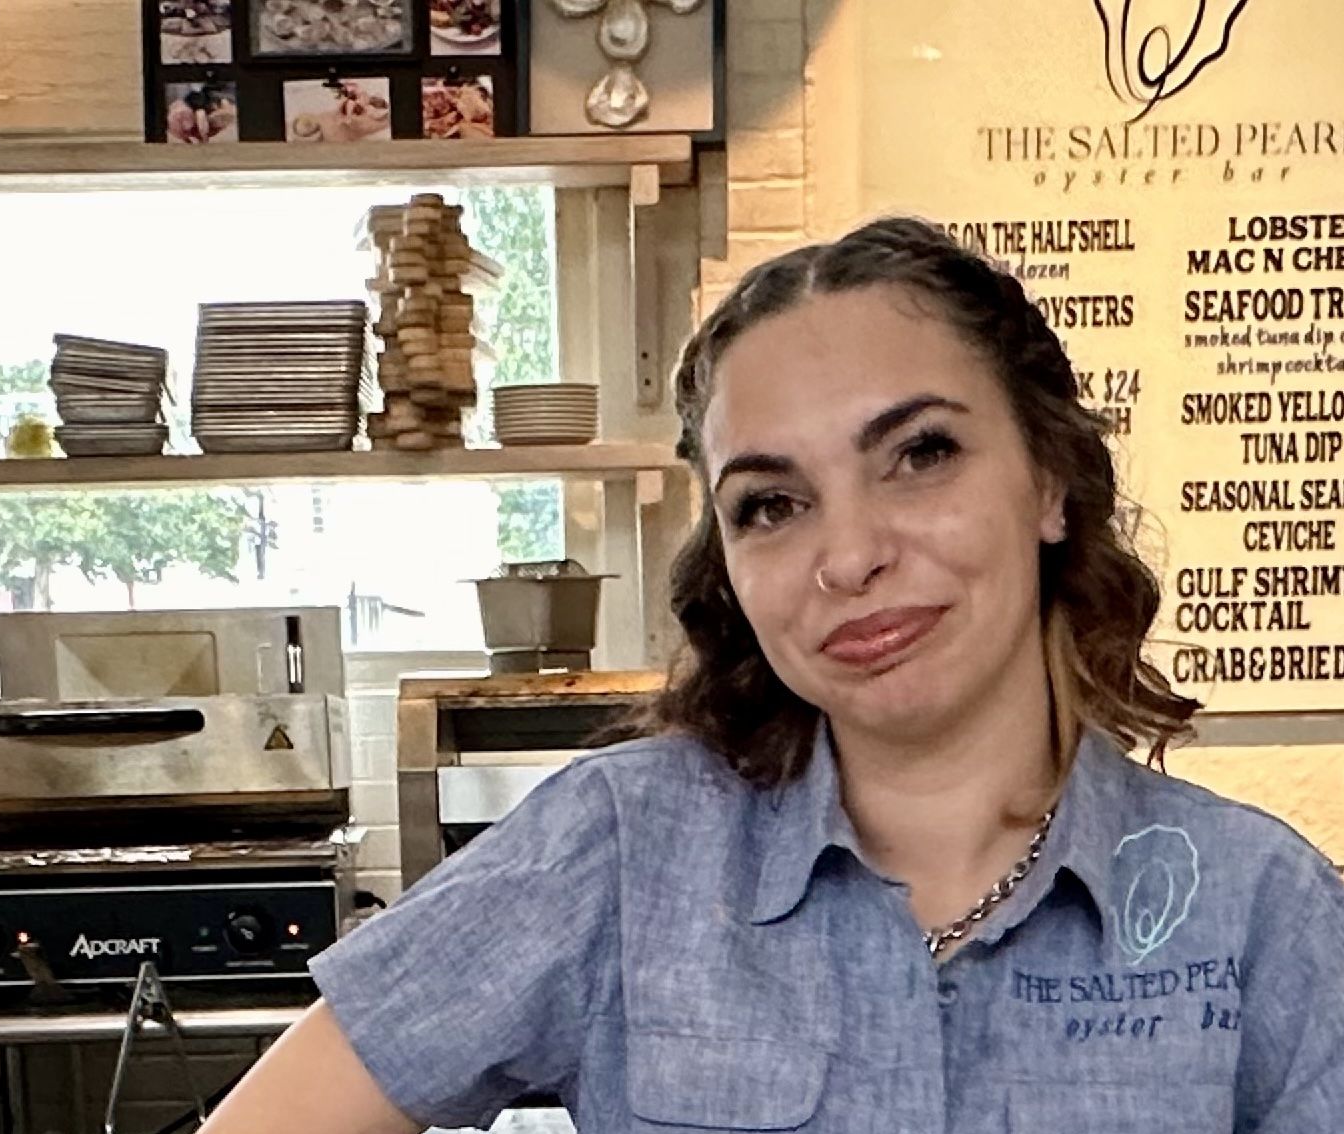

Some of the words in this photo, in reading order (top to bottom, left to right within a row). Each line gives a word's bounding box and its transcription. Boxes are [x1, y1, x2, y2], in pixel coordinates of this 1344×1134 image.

[977, 126, 1056, 161] THE
[1067, 123, 1221, 160] SALTED
[1033, 166, 1182, 193] oyster
[1222, 160, 1292, 184] bar
[962, 222, 987, 252] ON
[992, 221, 1027, 254] THE
[1031, 218, 1135, 254] HALFSHELL
[1015, 253, 1070, 280] dozen
[1186, 248, 1255, 275] MAC
[1262, 247, 1284, 273] N
[1184, 288, 1304, 323] SEAFOOD
[1184, 325, 1252, 348] smoked
[1257, 326, 1300, 346] tuna
[1303, 322, 1334, 355] dip
[1216, 351, 1282, 386] shrimp
[1104, 367, 1141, 405] $24
[1181, 392, 1272, 425] SMOKED
[1240, 431, 1299, 465] TUNA
[1305, 431, 1343, 463] DIP
[1180, 479, 1295, 512] SEASONAL
[1243, 520, 1336, 552] CEVICHE
[1176, 566, 1248, 598] GULF
[1175, 600, 1311, 632] COCKTAIL
[1013, 967, 1061, 1004] THE
[1069, 968, 1180, 1004] SALTED
[1185, 956, 1248, 993] PEA
[1066, 1010, 1164, 1043] oyster
